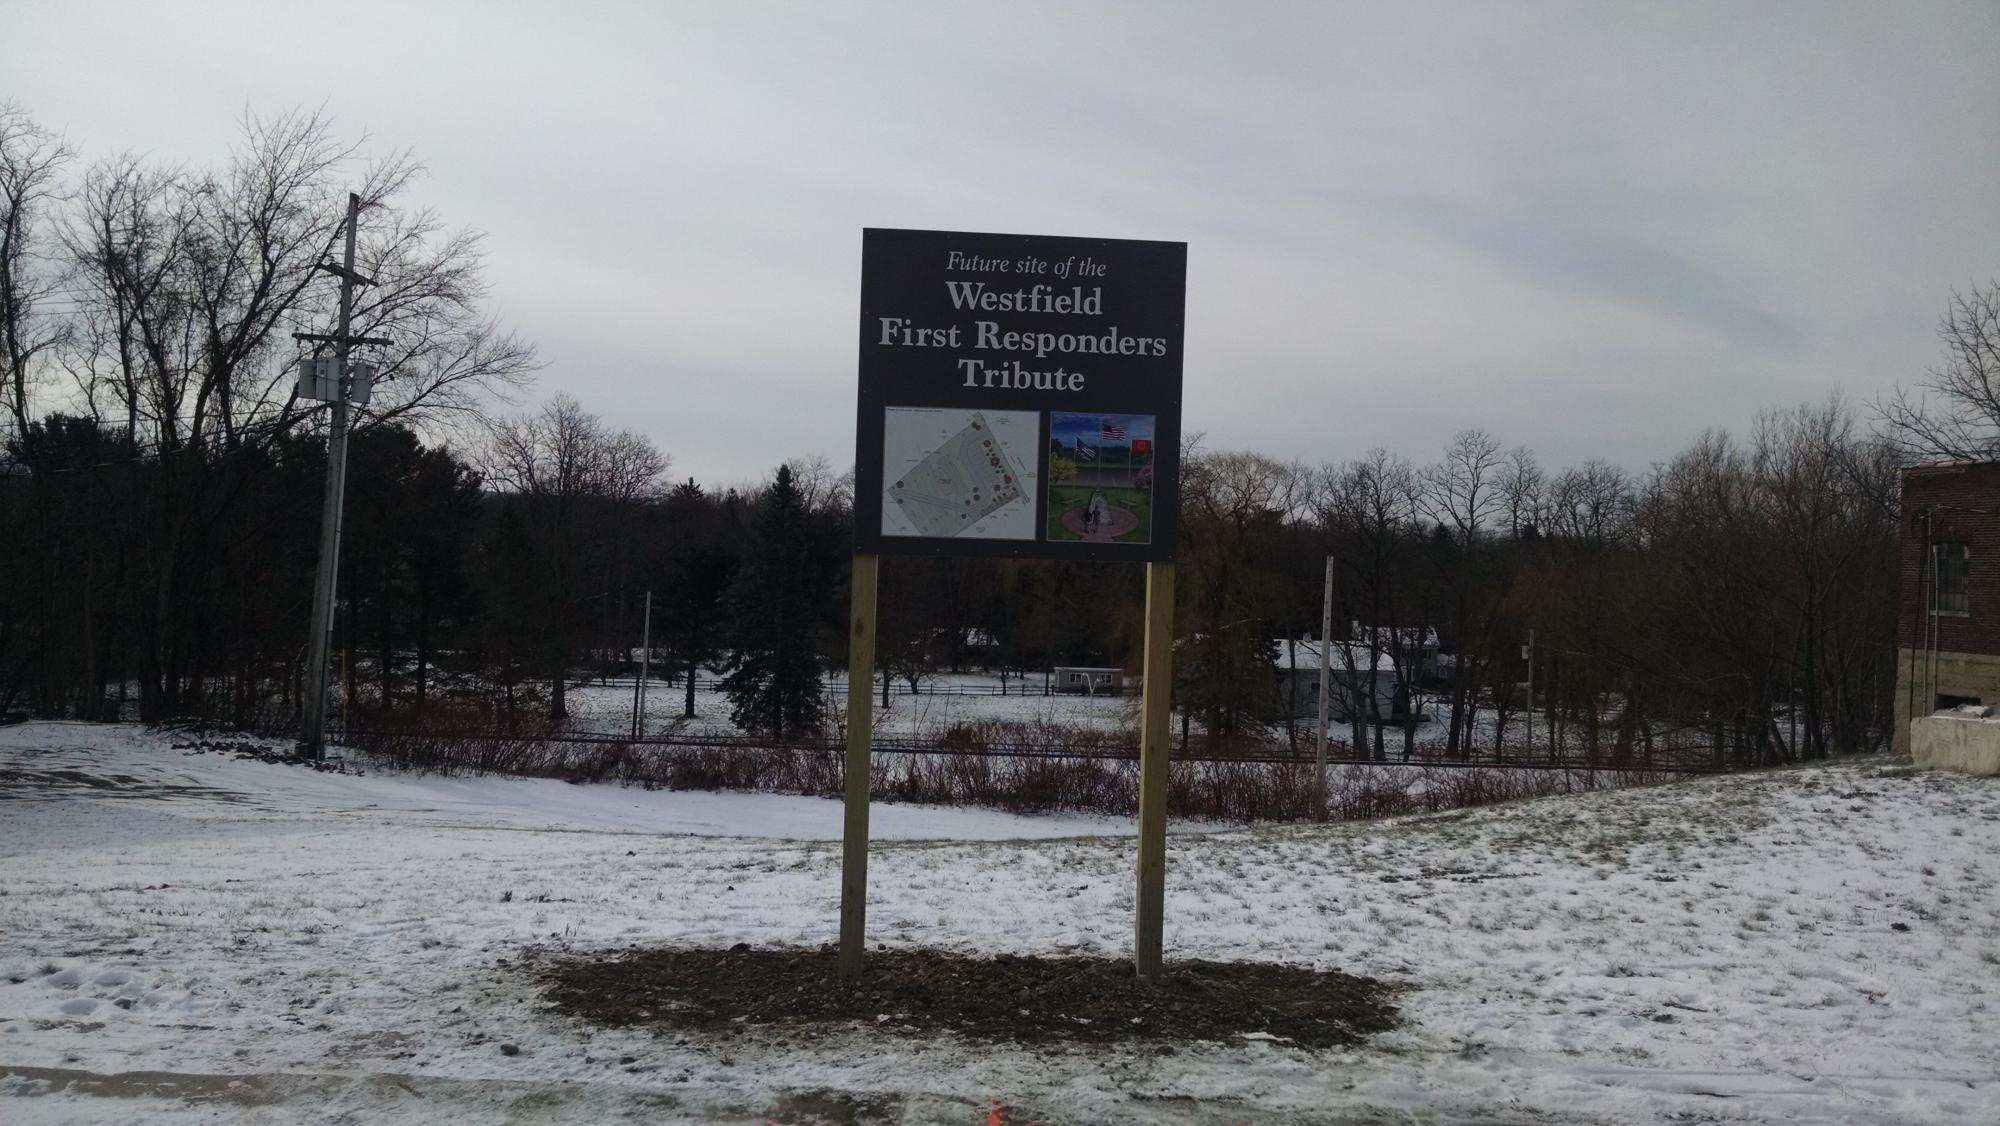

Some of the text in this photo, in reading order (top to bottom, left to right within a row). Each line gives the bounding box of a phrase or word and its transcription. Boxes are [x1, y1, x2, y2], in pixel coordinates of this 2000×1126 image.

[946, 251, 1106, 279] Future site of the
[945, 281, 1102, 315] Westfield
[878, 317, 1167, 358] First Responders
[957, 359, 1085, 391] Tribute
